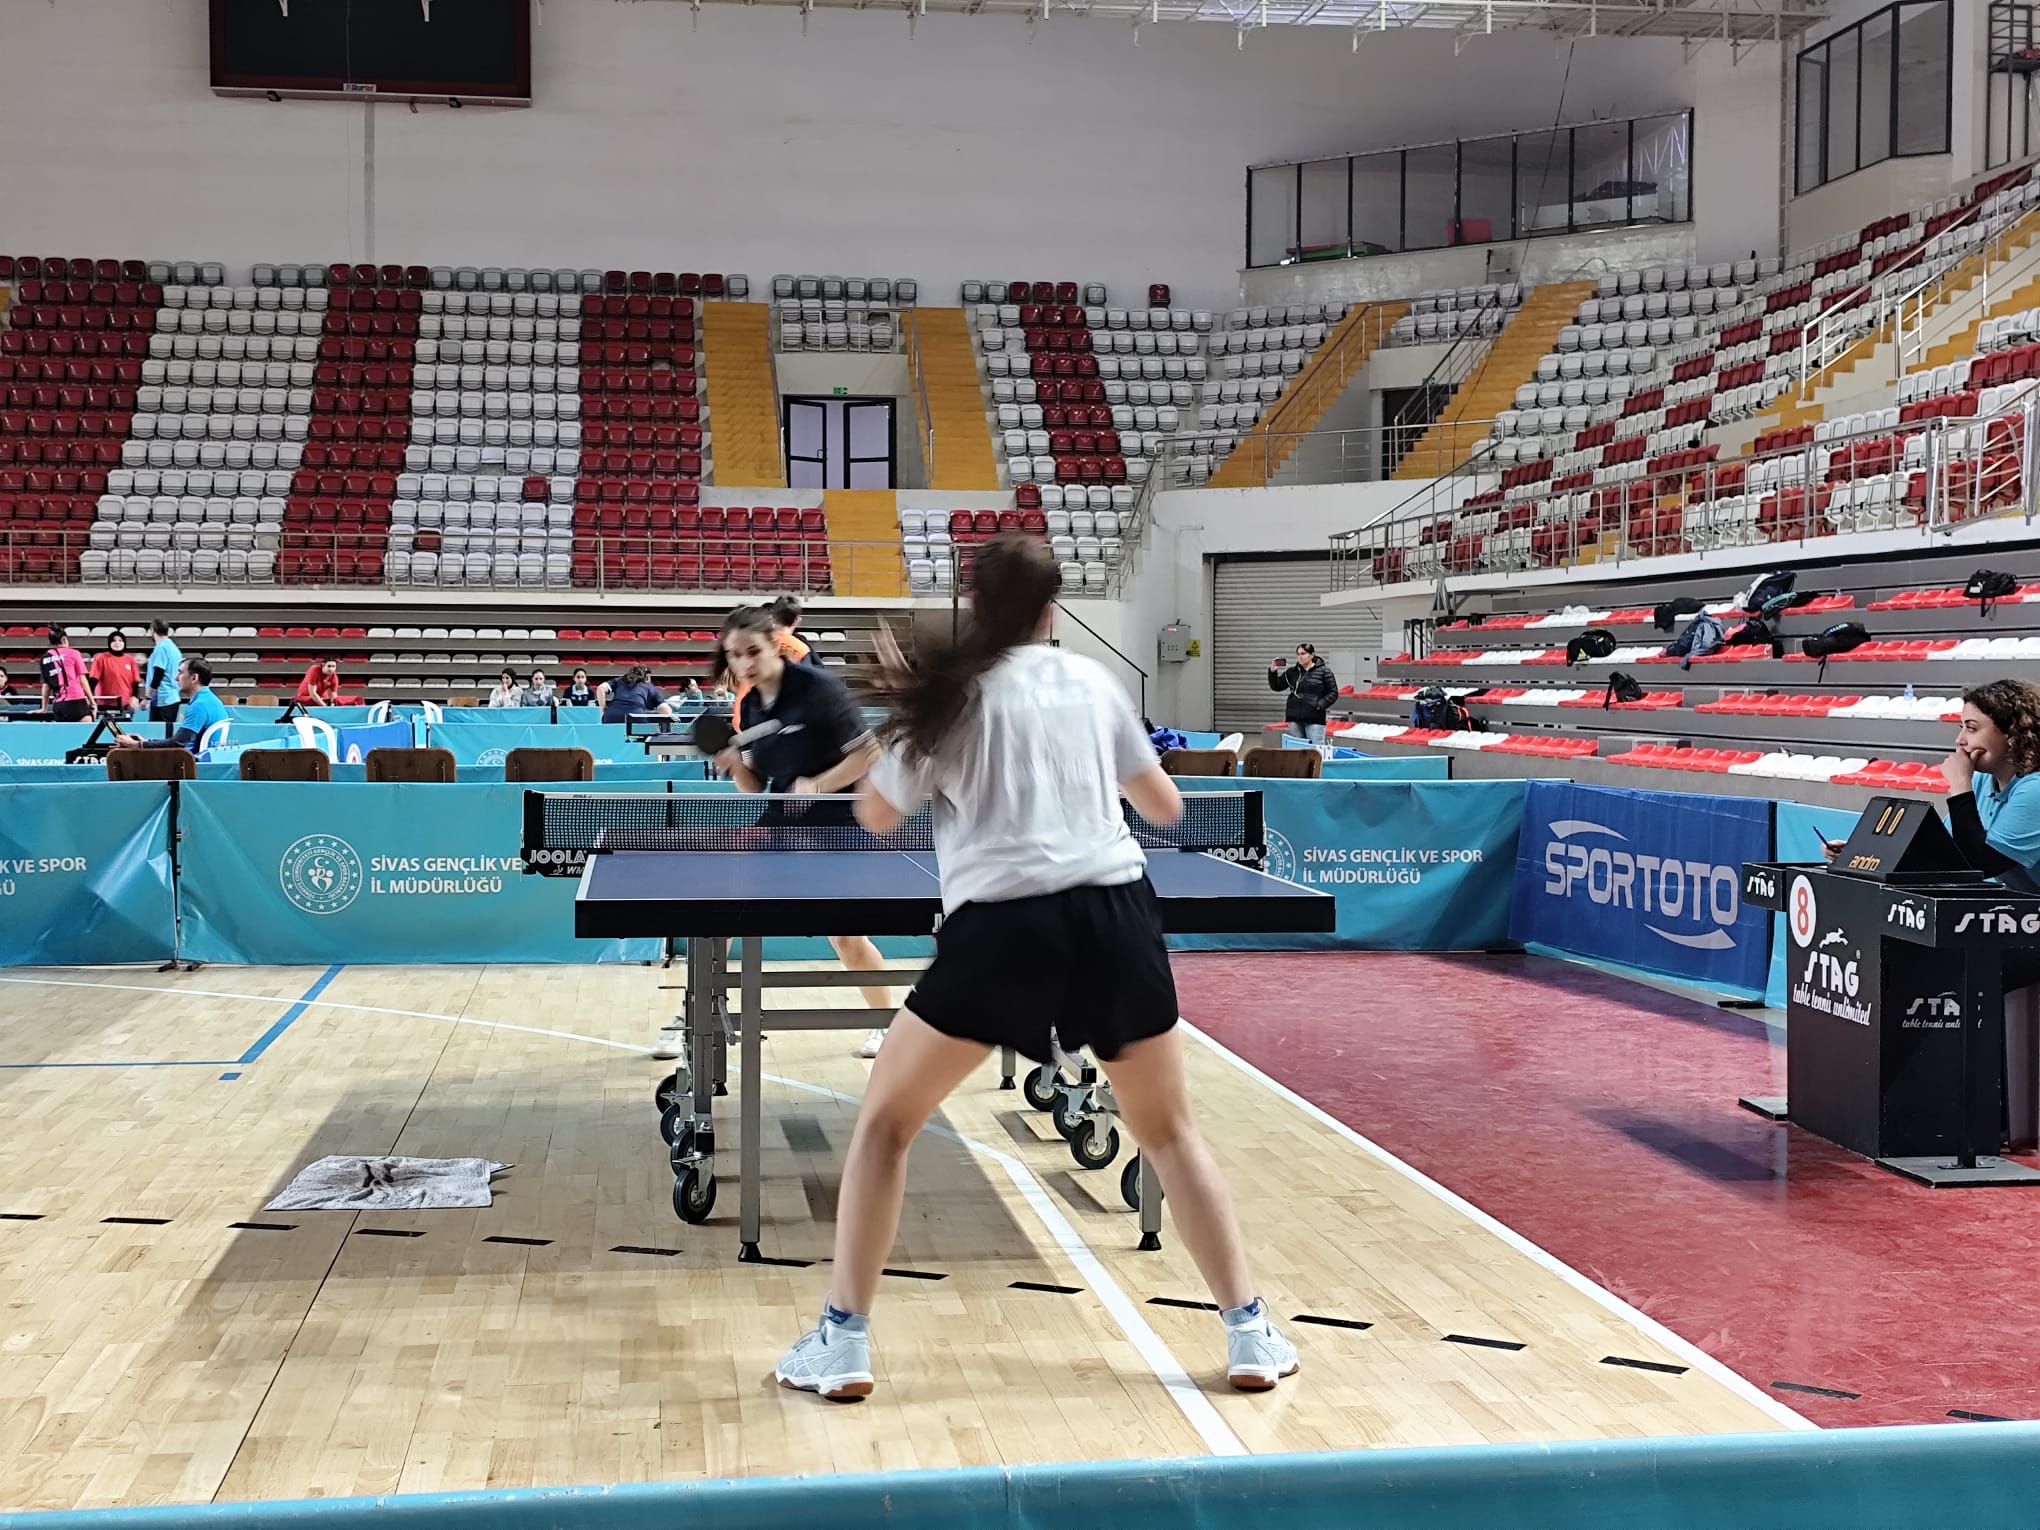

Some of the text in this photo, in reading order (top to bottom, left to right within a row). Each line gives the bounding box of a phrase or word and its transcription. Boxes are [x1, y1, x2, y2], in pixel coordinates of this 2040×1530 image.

[13, 860, 35, 874] VE
[39, 857, 87, 873] SPOR
[371, 854, 522, 875] SİVAS GENÇLİK VE
[529, 849, 586, 864] JOOLA
[1303, 846, 1483, 867] SİVAS GENÇLİK VE SPOR
[371, 876, 502, 894] İL MÜDÜRLÜĞÜ
[1303, 867, 1421, 884] İL MÜDÜRLÜĞÜ
[1747, 876, 1775, 898] STAG
[1797, 886, 1810, 936] 8
[1887, 904, 1926, 930] STAG
[1954, 913, 2040, 934] STAG
[1804, 951, 1860, 997] STAG
[1793, 983, 1872, 1026] table tennis unlimited
[1906, 998, 1961, 1016] STA
